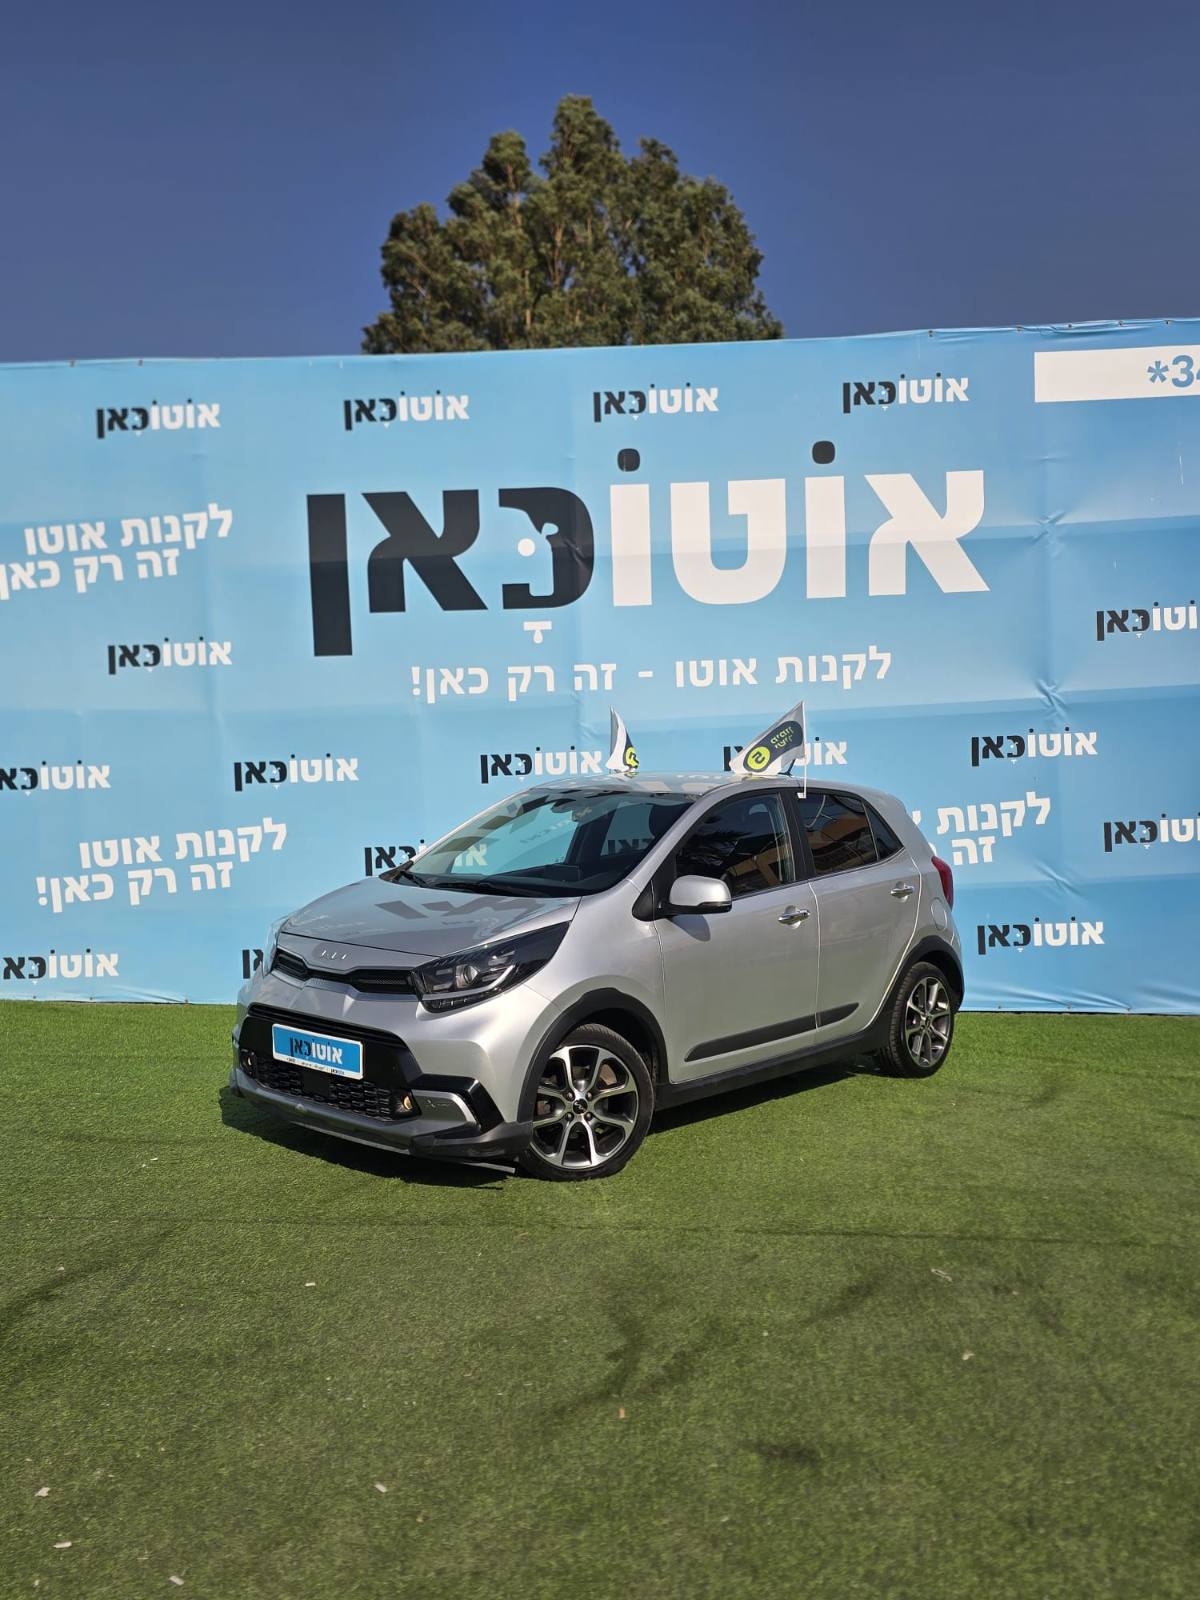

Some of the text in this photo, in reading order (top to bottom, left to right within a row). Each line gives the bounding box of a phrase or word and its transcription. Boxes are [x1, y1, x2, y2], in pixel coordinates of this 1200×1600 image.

[24, 503, 233, 555] לקנות אוטו
[73, 554, 124, 593] רק
[136, 548, 180, 579] זה
[411, 665, 489, 704] כאן!
[508, 665, 555, 702] רק
[573, 664, 617, 691] זה
[675, 658, 758, 688] אוטו
[775, 645, 892, 690] לקנות
[936, 791, 1051, 837] לקנות
[79, 817, 287, 869] לקנות אוטו
[951, 835, 996, 866] זה
[36, 861, 233, 913] זה רק כאן!
